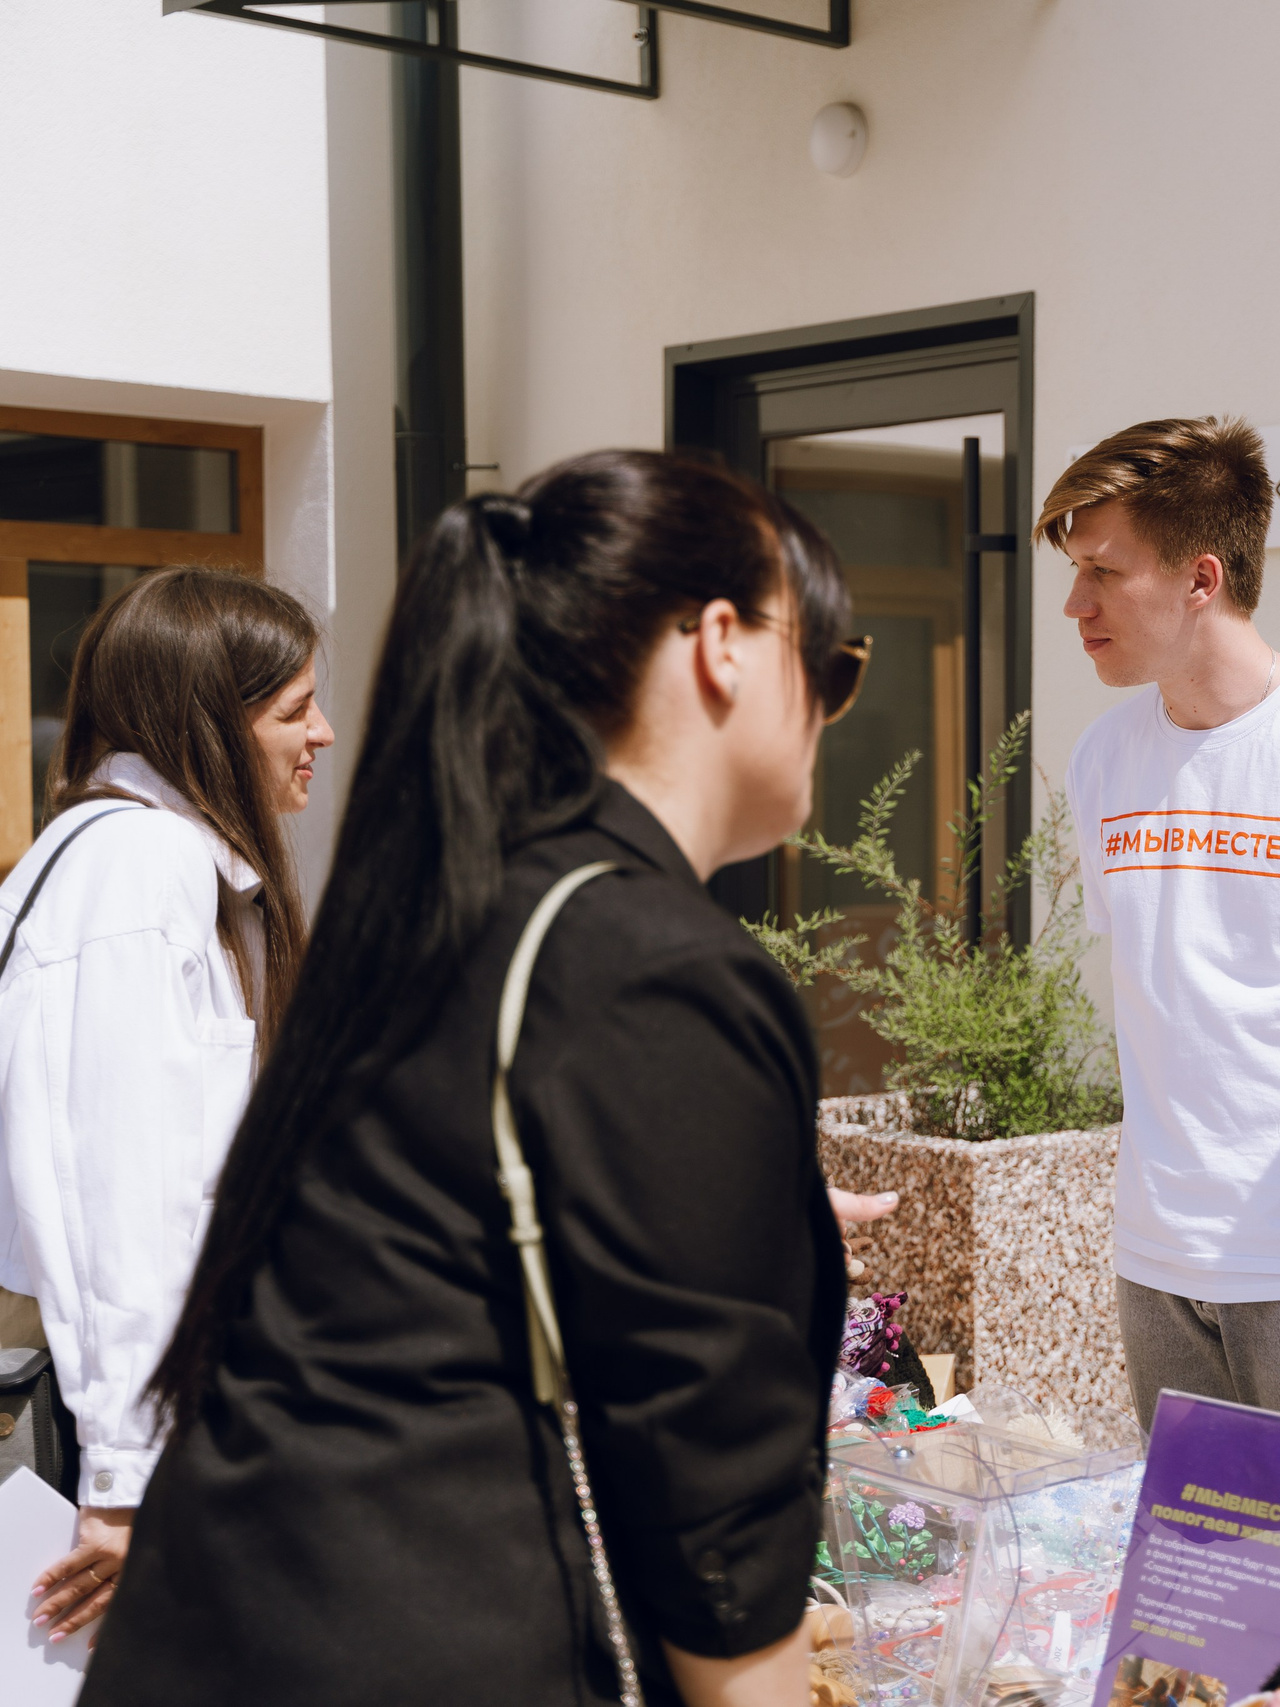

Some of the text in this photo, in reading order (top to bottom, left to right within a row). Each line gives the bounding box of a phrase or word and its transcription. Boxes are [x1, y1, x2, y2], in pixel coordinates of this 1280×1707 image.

[1151, 1503, 1241, 1537] помогаем
[1149, 1533, 1163, 1546] Все
[1163, 1539, 1206, 1556] собранные
[1206, 1550, 1241, 1565] средства
[1242, 1557, 1265, 1572] будут
[1152, 1550, 1174, 1562] фонд
[1174, 1556, 1208, 1570] приютов
[1207, 1565, 1223, 1574] для
[1223, 1566, 1268, 1586] бездомных
[1162, 1581, 1181, 1591] носа
[1181, 1585, 1192, 1594] до
[1191, 1573, 1214, 1586] чтобы
[1133, 1609, 1144, 1617] по
[1144, 1612, 1172, 1627] номеру
[1136, 1593, 1247, 1631] Перечислить средства можно
